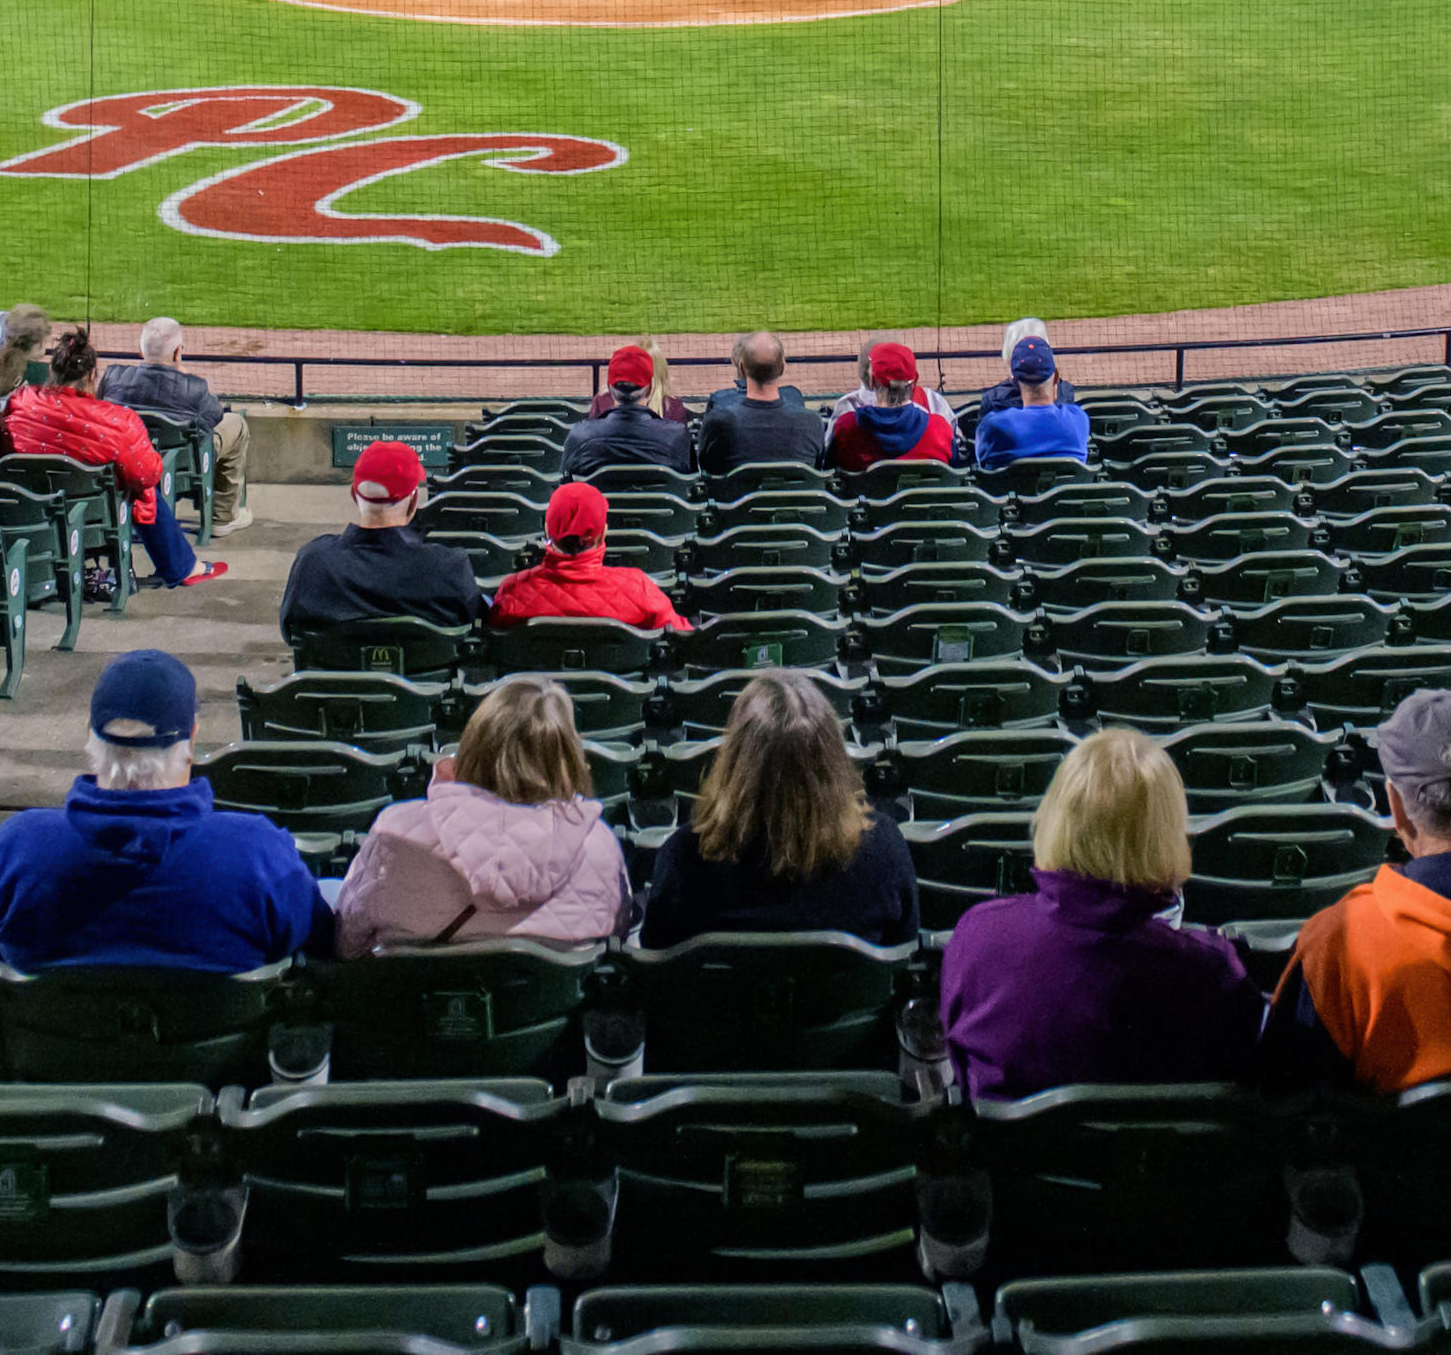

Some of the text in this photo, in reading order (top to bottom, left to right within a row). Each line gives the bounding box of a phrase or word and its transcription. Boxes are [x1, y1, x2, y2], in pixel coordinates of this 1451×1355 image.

[347, 432, 441, 441] Please be aware of
[425, 443, 442, 452] the
